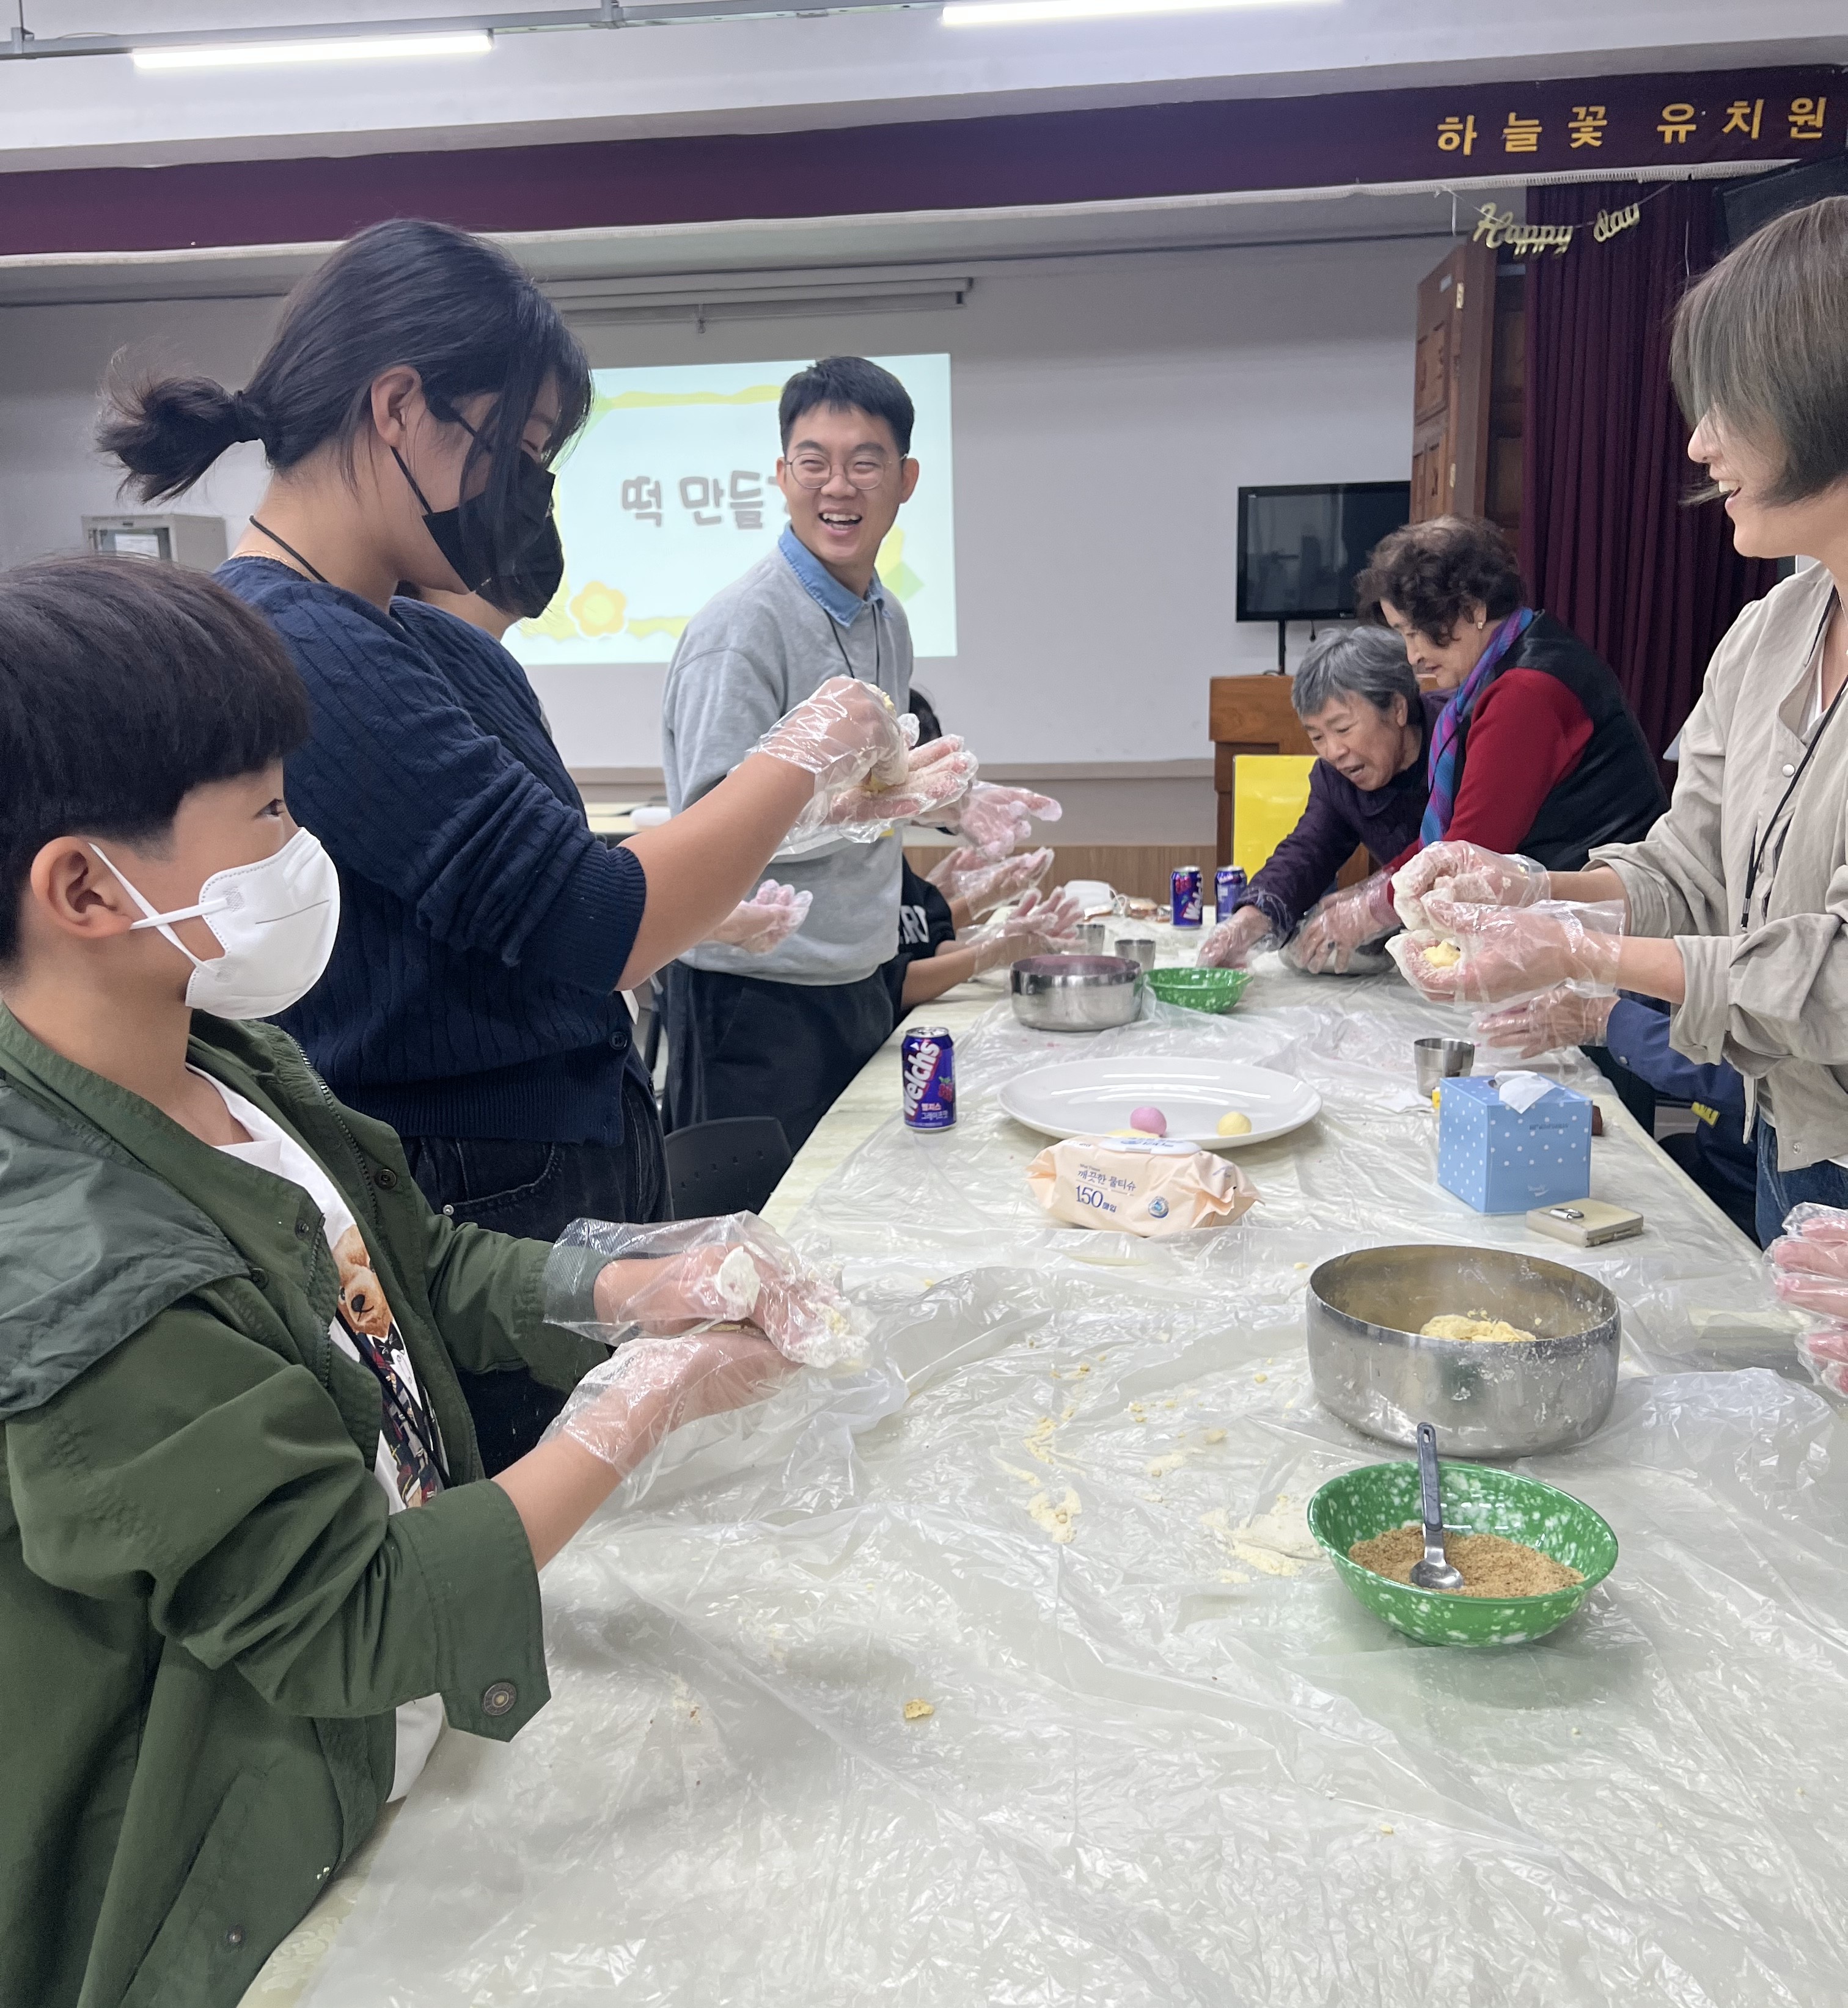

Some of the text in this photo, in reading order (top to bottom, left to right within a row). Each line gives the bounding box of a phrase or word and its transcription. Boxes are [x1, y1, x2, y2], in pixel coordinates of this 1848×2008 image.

[1437, 96, 1827, 156] 하늘꽃 유치원
[1472, 202, 1574, 258] Happy
[622, 475, 662, 527] 떡
[1077, 1170, 1137, 1192] 깨끗한 물티슈
